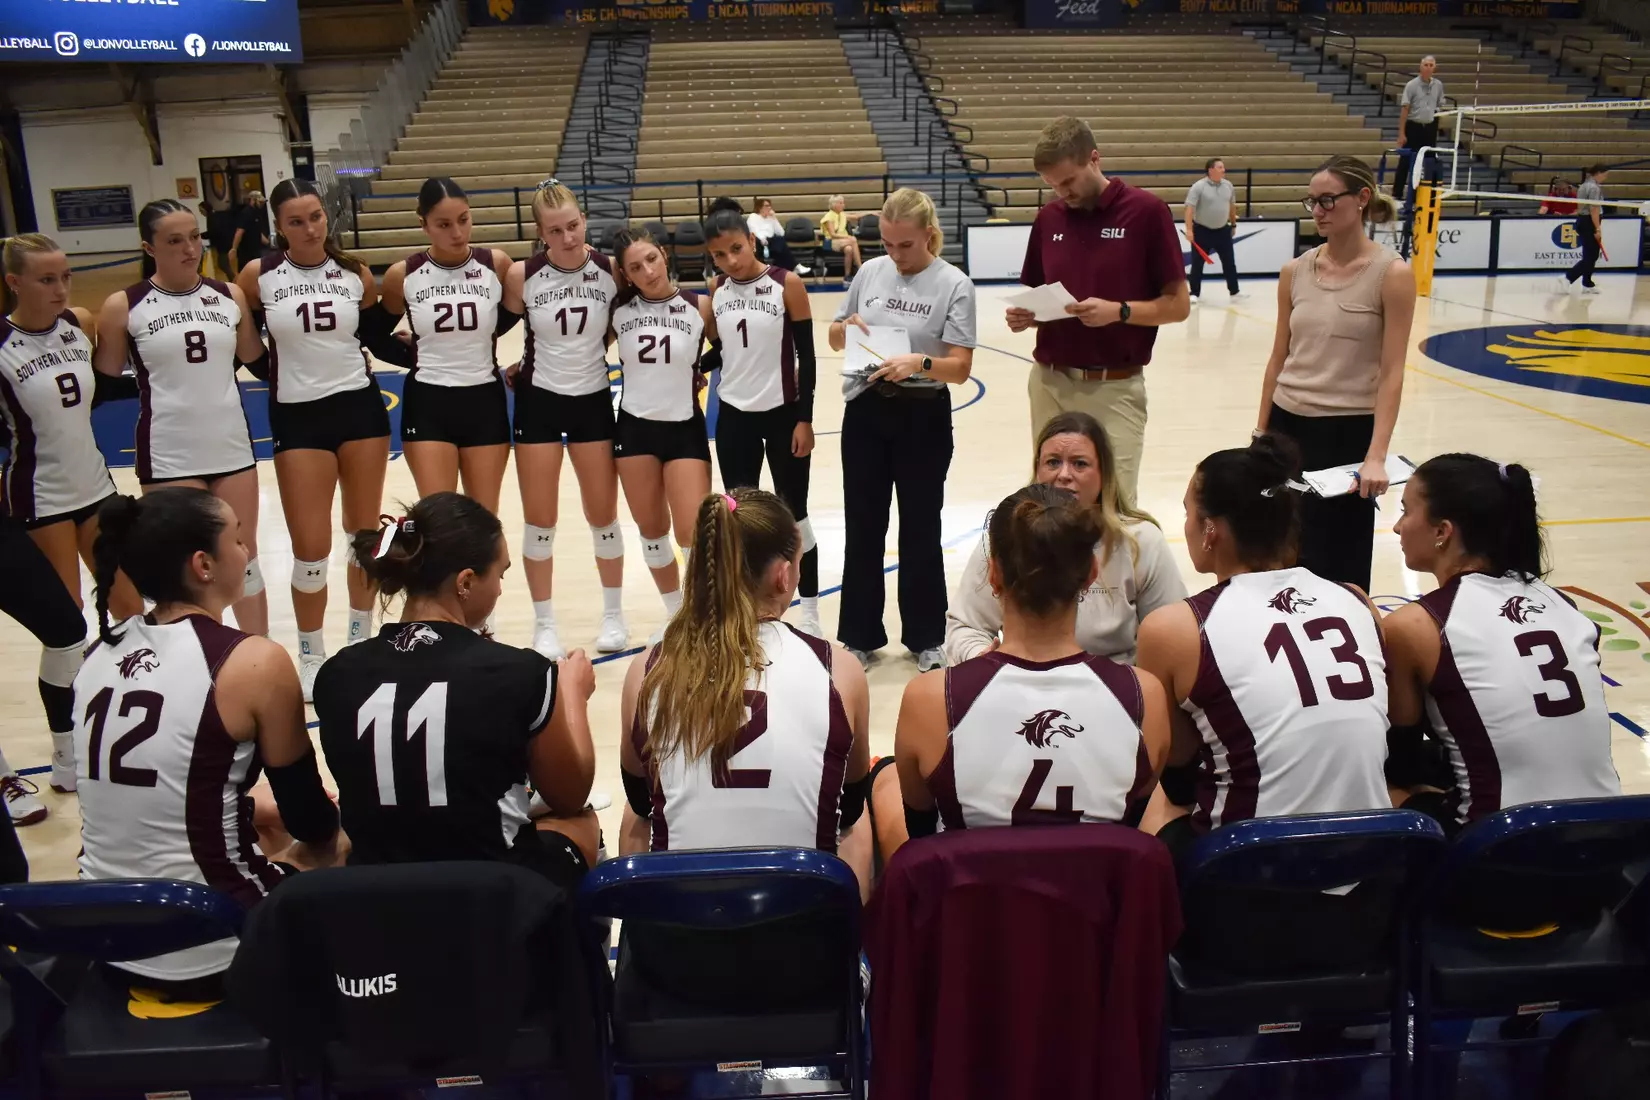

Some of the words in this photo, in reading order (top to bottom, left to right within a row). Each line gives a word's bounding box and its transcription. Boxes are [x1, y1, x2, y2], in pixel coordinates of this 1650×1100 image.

[719, 4, 748, 18] NCAA
[752, 2, 834, 17] TOURNAMENTS
[1209, 0, 1237, 13] NCAA
[1335, 1, 1363, 14] NCAA
[1366, 1, 1438, 15] TOURNAMENTS
[83, 38, 177, 50] @LIONVOLLEYBALL
[211, 40, 291, 52] /LIONVOLLEYBALL
[1100, 228, 1125, 239] SIU
[1535, 252, 1555, 260] EAST
[1557, 252, 1583, 260] TEXAS
[274, 284, 316, 302] SOUTHERN
[317, 283, 351, 300] ILLINOIS
[415, 285, 456, 303] SOUTHERN
[458, 284, 490, 300] ILLINOIS
[534, 287, 574, 307] SOUTHERN
[575, 286, 607, 304] ILLINOIS
[885, 298, 932, 315] SALUKI
[296, 301, 336, 333] 15
[433, 302, 478, 333] 20
[555, 306, 588, 336] 17
[747, 299, 778, 316] ILLINOIS
[148, 311, 194, 335] SOUTHERN
[195, 310, 230, 328] ILLINOIS
[620, 316, 658, 335] SOUTHERN
[660, 317, 692, 335] ILLINOIS
[736, 318, 748, 348] 1
[184, 331, 208, 363] 8
[638, 335, 671, 364] 21
[16, 351, 62, 383] SOUTHERN
[55, 373, 81, 408] 9
[1263, 616, 1375, 708] 13
[1513, 630, 1586, 718] 3
[83, 686, 164, 788] 12
[357, 681, 448, 807] 11
[710, 689, 772, 789] 2
[1011, 759, 1084, 826] 4
